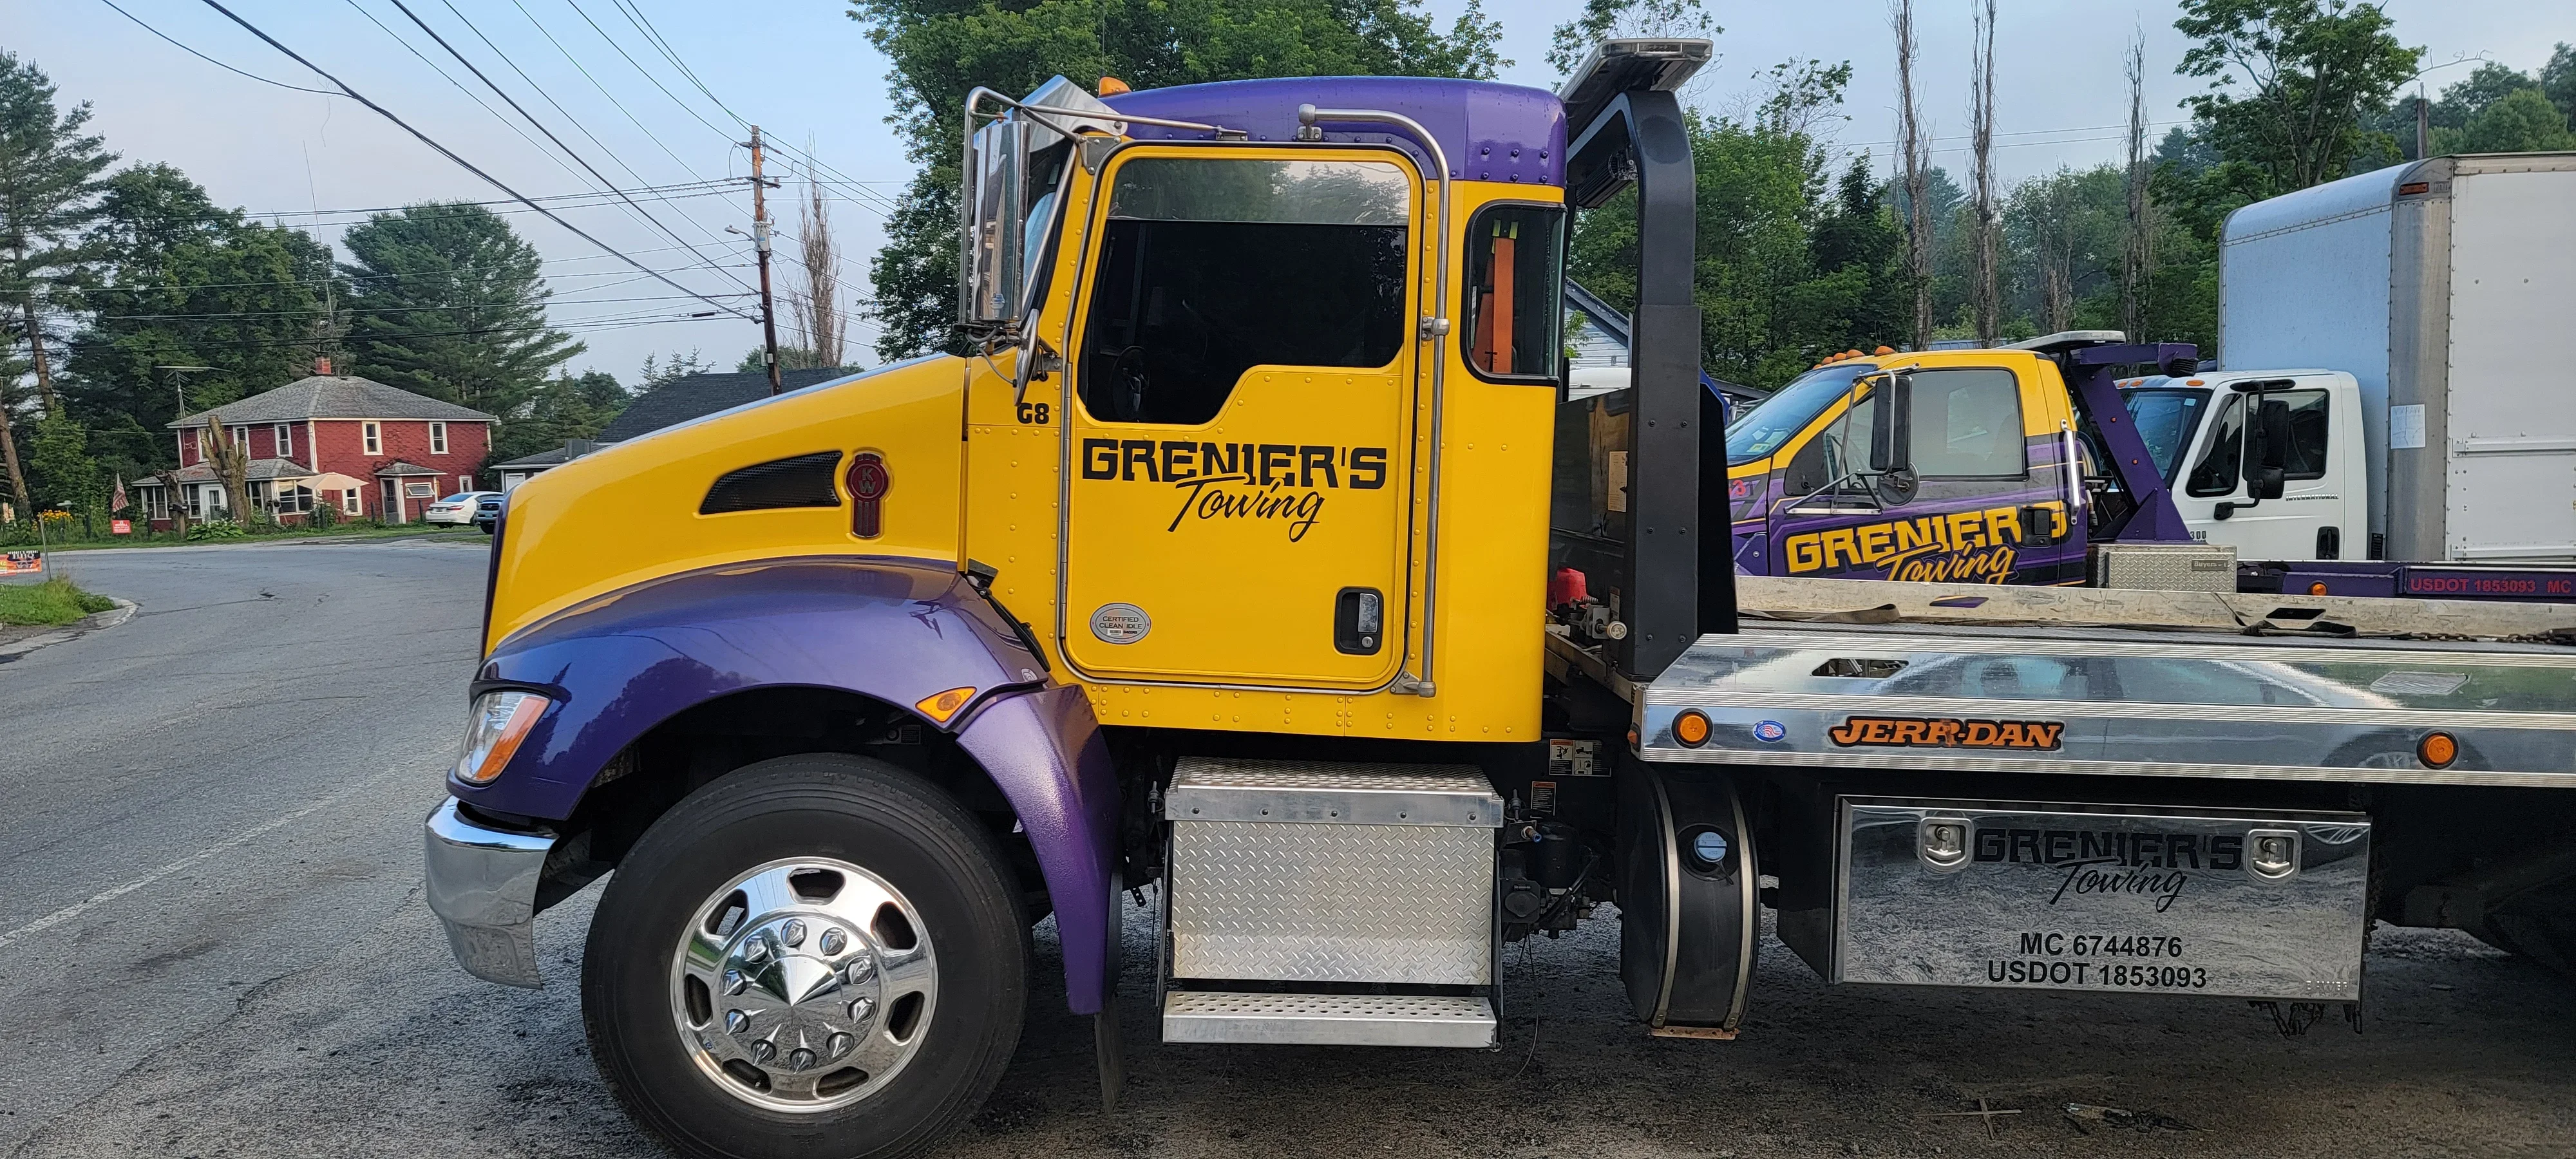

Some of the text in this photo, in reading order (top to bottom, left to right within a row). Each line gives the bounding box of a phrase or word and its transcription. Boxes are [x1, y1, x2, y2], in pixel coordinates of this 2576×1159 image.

[1017, 402, 1050, 425] G8
[1083, 438, 1387, 489] GRENIER'S
[1168, 475, 1325, 542] Towing
[1785, 500, 2067, 574] GRENIER
[1875, 542, 2016, 583] Towing
[2410, 578, 2571, 594] USDOT 1853093 MC
[1832, 719, 2061, 748] JERR-DAN
[1973, 828, 2243, 870] GRENIER'S
[2049, 858, 2188, 914] Towing
[2020, 932, 2183, 958] MC 6744876
[1988, 960, 2207, 988] USDOT 1853093
